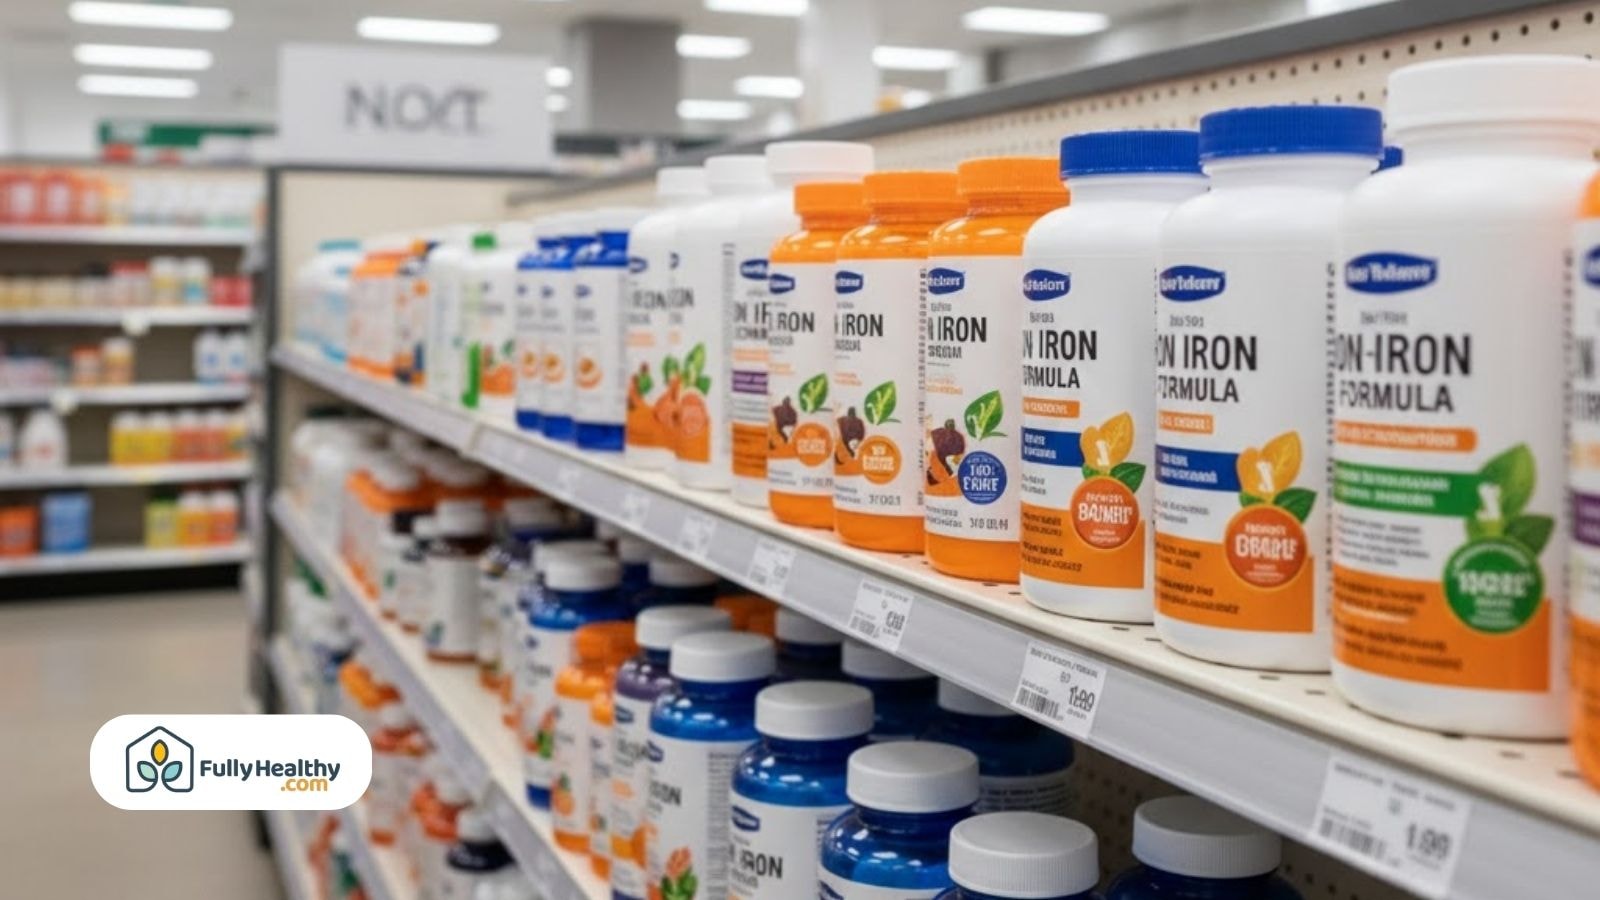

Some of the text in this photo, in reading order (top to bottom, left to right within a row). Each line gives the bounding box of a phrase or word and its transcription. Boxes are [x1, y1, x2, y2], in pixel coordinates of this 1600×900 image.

[937, 315, 988, 343] IRON
[1038, 329, 1098, 361] IRON
[1183, 334, 1258, 371] IRON
